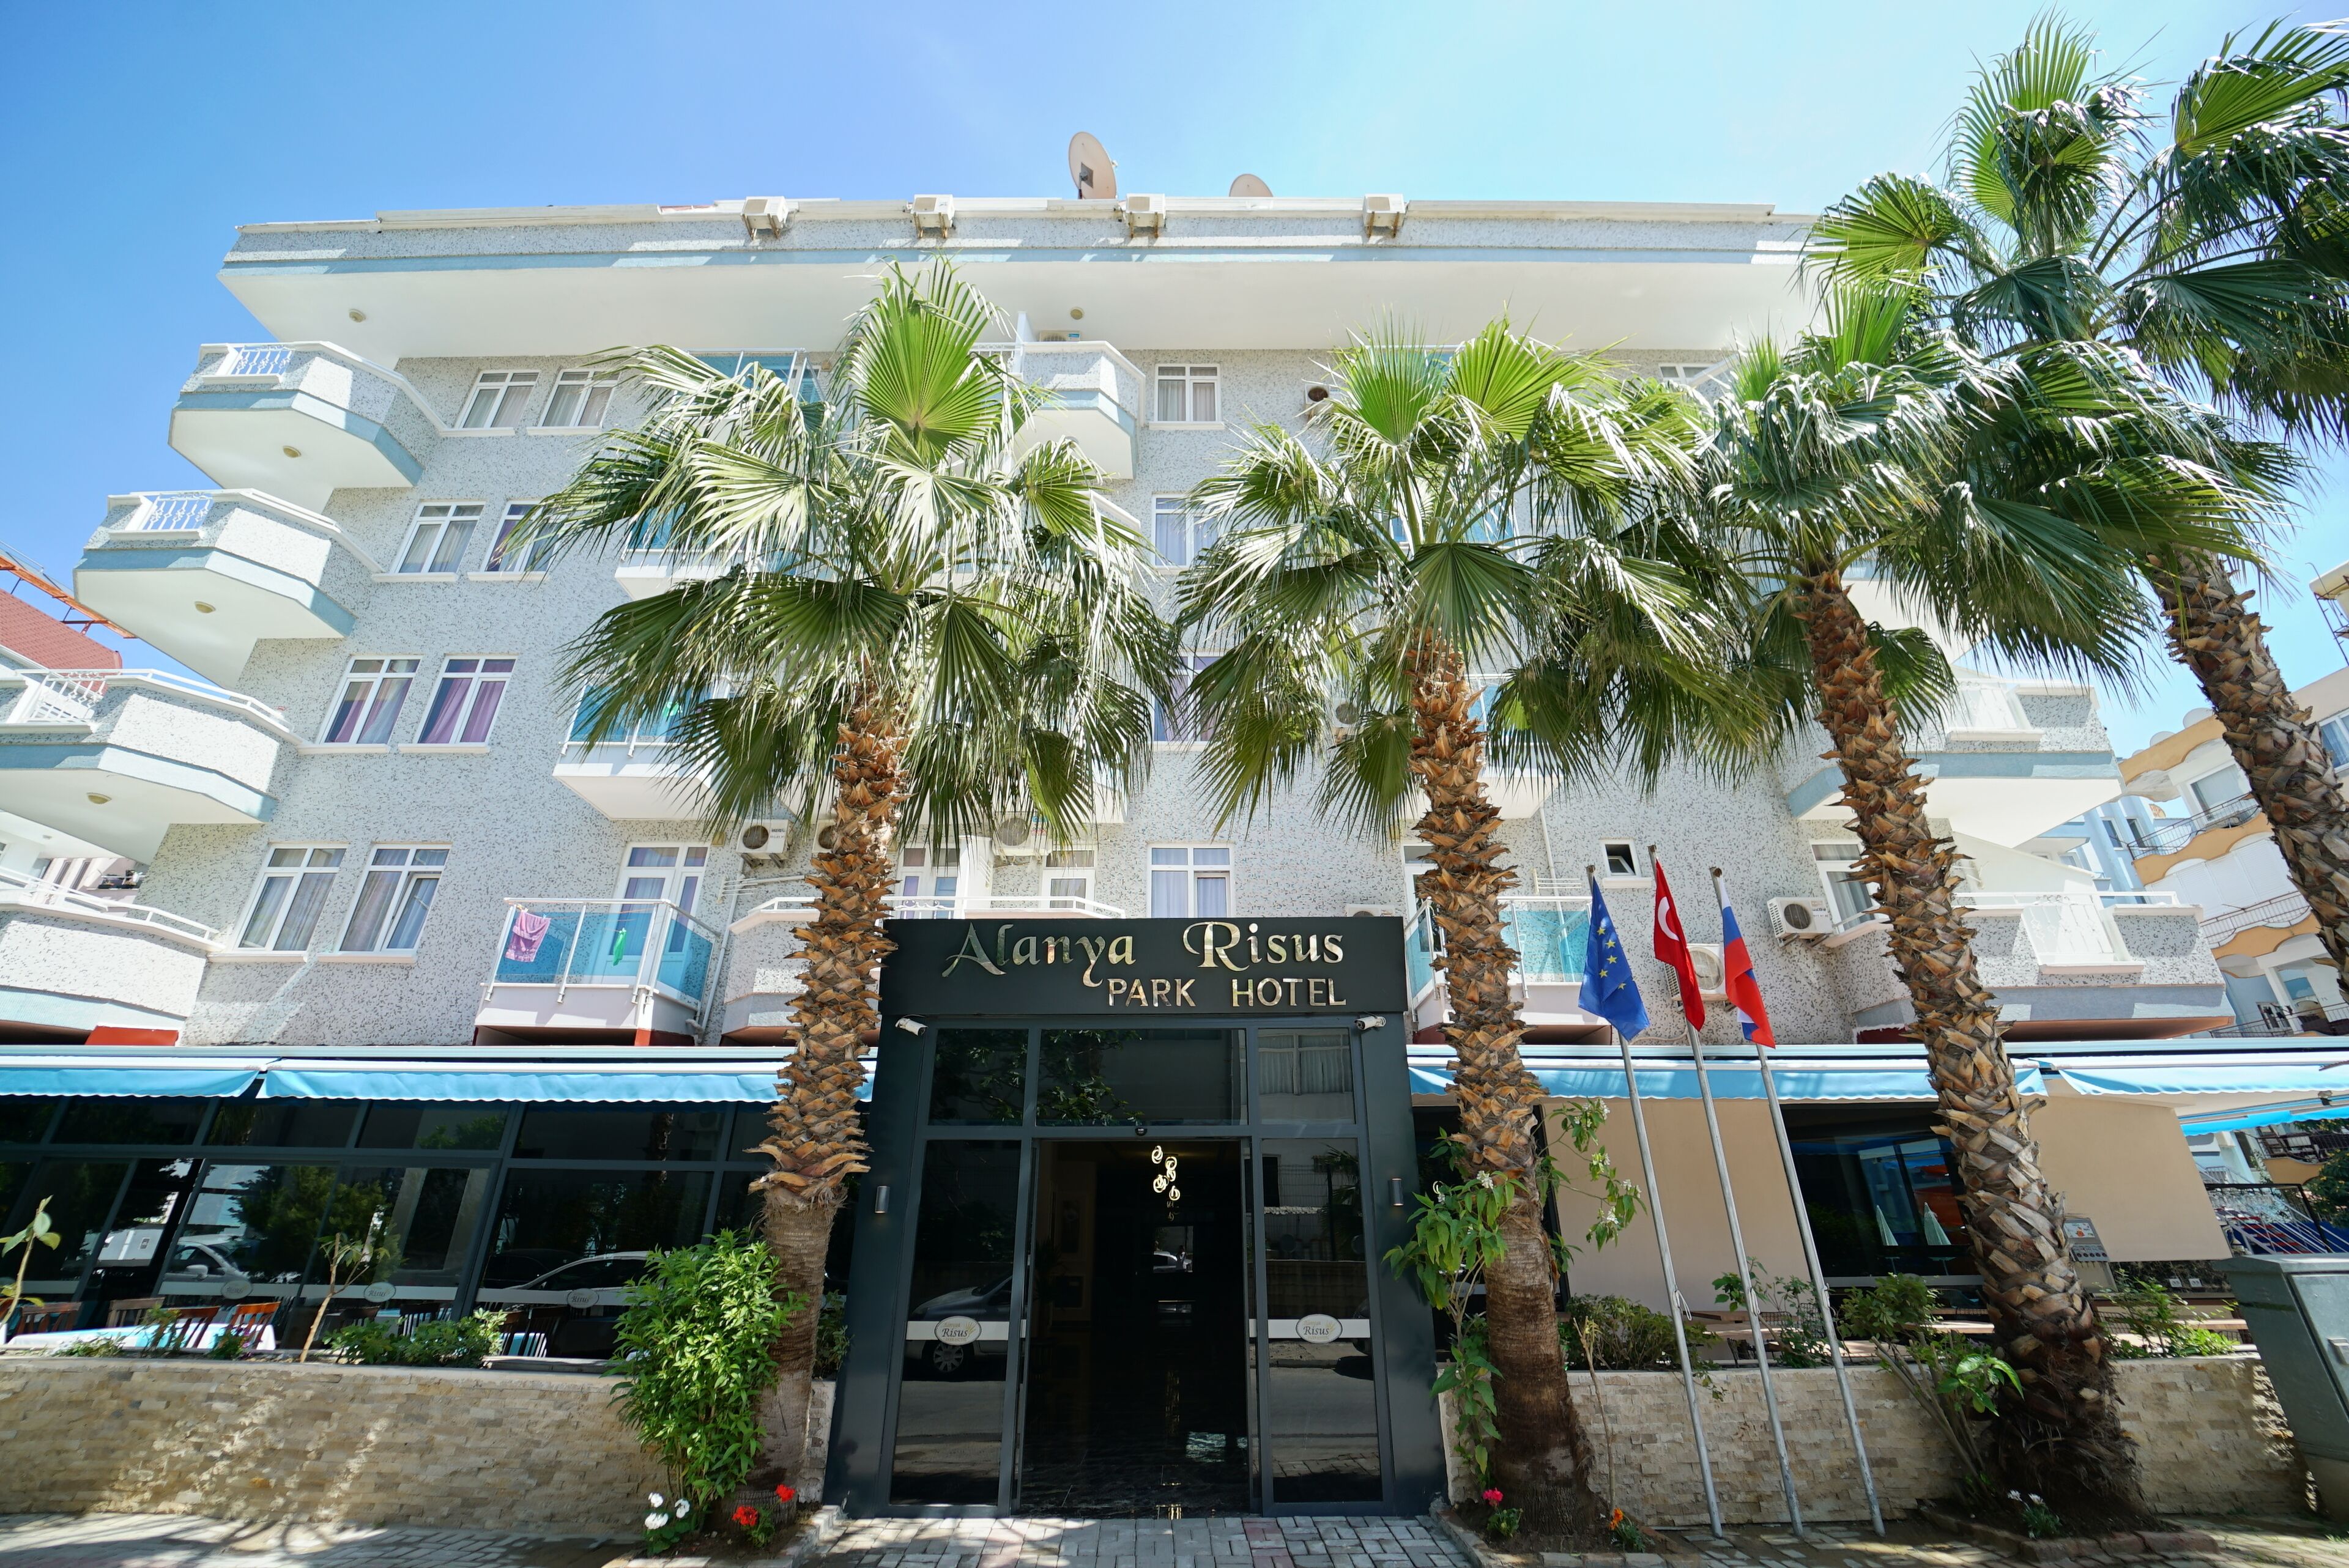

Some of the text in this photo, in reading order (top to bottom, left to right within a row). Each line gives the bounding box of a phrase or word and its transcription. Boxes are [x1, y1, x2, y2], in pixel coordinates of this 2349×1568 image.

[941, 922, 1343, 988] Alanya Risus
[1108, 978, 1346, 1007] PARK HOTEL
[942, 1328, 968, 1337] Risus
[1303, 1326, 1330, 1335] Risus
